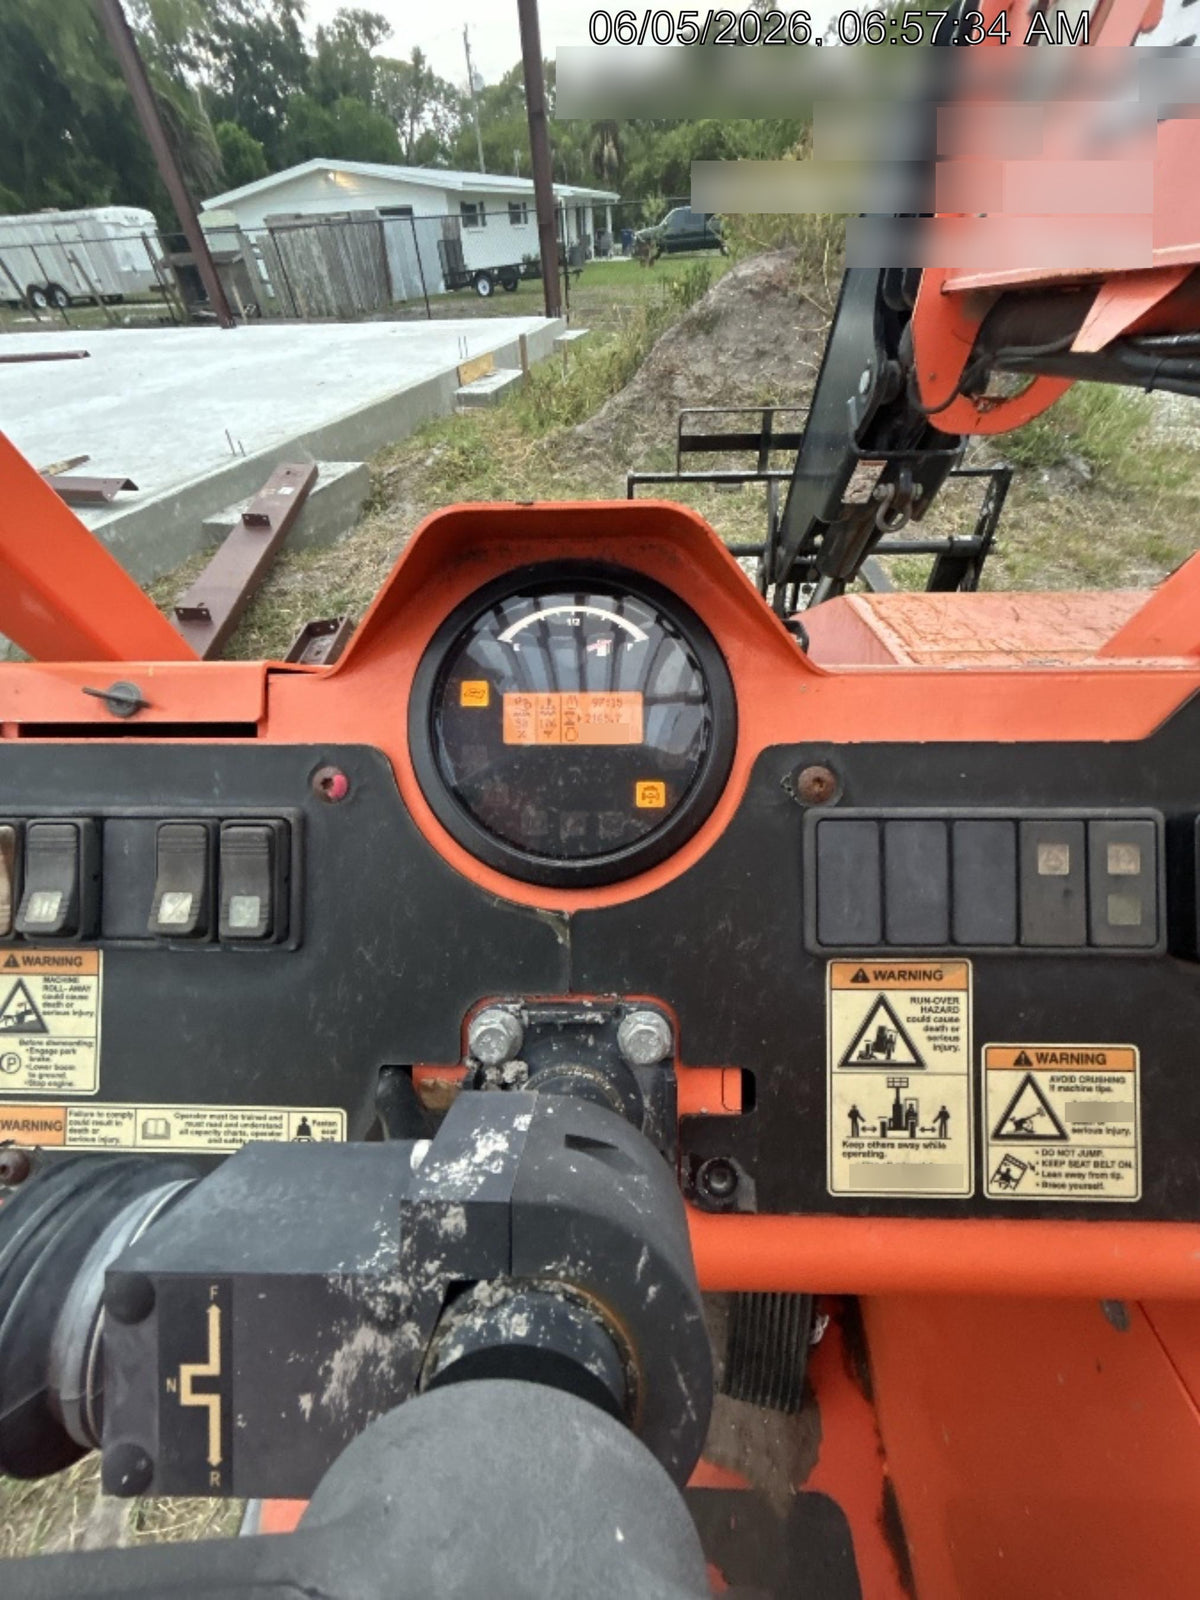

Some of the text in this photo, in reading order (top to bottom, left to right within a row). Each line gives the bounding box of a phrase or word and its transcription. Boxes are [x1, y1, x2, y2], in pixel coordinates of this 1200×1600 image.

[22, 956, 83, 967] WARNING
[873, 970, 944, 982] WARNING
[910, 997, 960, 1005] RUN-OVER
[926, 1034, 960, 1042] serious
[1035, 1052, 1107, 1065] WARNING
[1050, 1074, 1126, 1084] AVOID CRUSHING
[106, 1112, 134, 1120] comply
[0, 1120, 63, 1132] WARNING
[190, 1130, 222, 1138] capacity
[1072, 1127, 1103, 1135] serious
[842, 1141, 946, 1150] Keep others away while
[1042, 1148, 1055, 1156] DO
[1057, 1149, 1075, 1157] NOT
[1093, 1160, 1116, 1168] BELT
[1064, 1172, 1086, 1180] away
[1087, 1171, 1108, 1179] from
[210, 1286, 218, 1300] F
[166, 1377, 177, 1393] N
[210, 1472, 220, 1487] R
